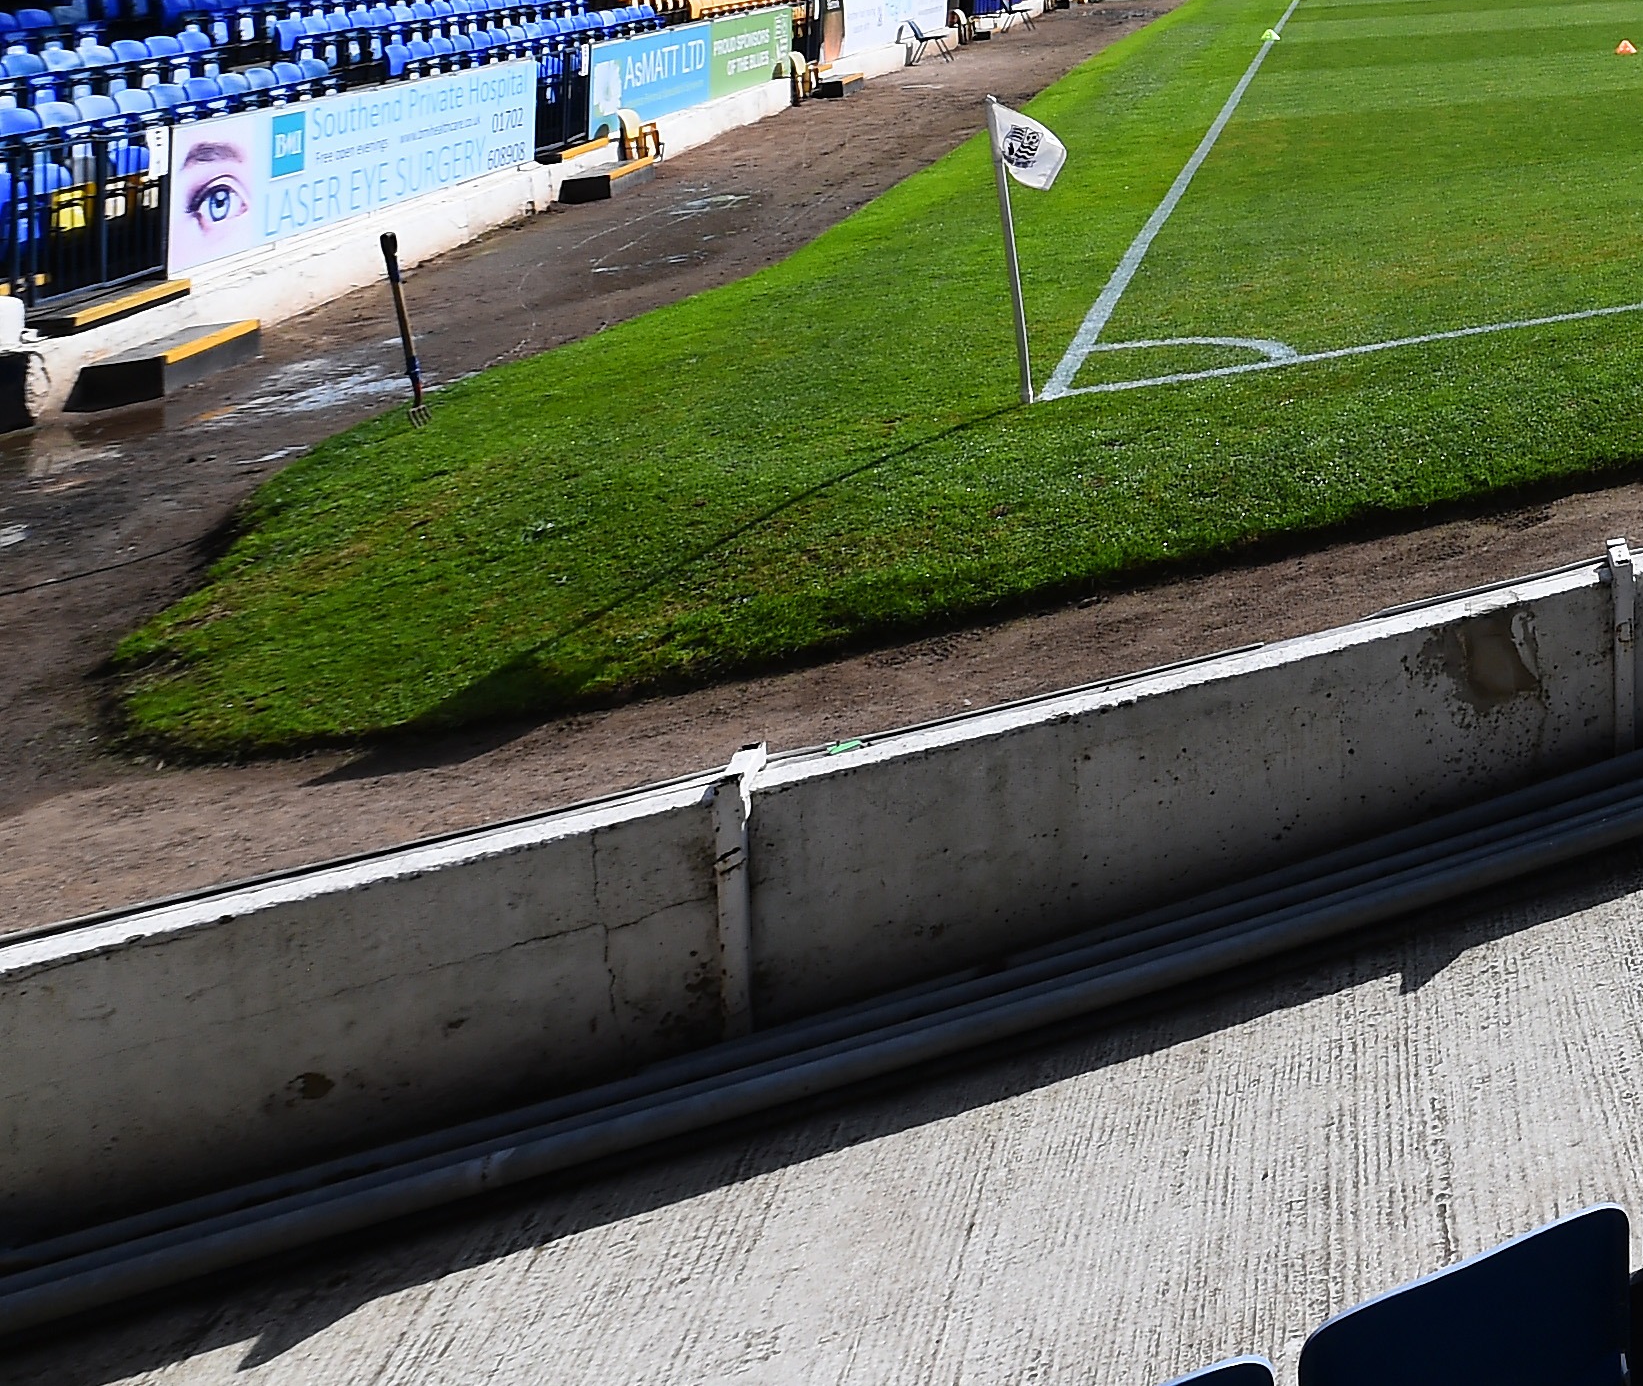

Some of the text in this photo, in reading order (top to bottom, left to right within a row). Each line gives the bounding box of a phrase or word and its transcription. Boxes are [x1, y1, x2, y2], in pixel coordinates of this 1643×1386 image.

[713, 36, 736, 56] PROUD
[736, 28, 770, 50] SPONSORS
[623, 39, 705, 90] AsMATT LTD
[727, 59, 736, 76] OF
[749, 50, 769, 69] BLUES
[311, 70, 527, 142] Southend Private Hospital
[491, 107, 524, 134] 01702
[315, 138, 391, 165] Free open evenings
[487, 141, 526, 171] 608908
[264, 135, 487, 237] LASER EYE SURGERY
